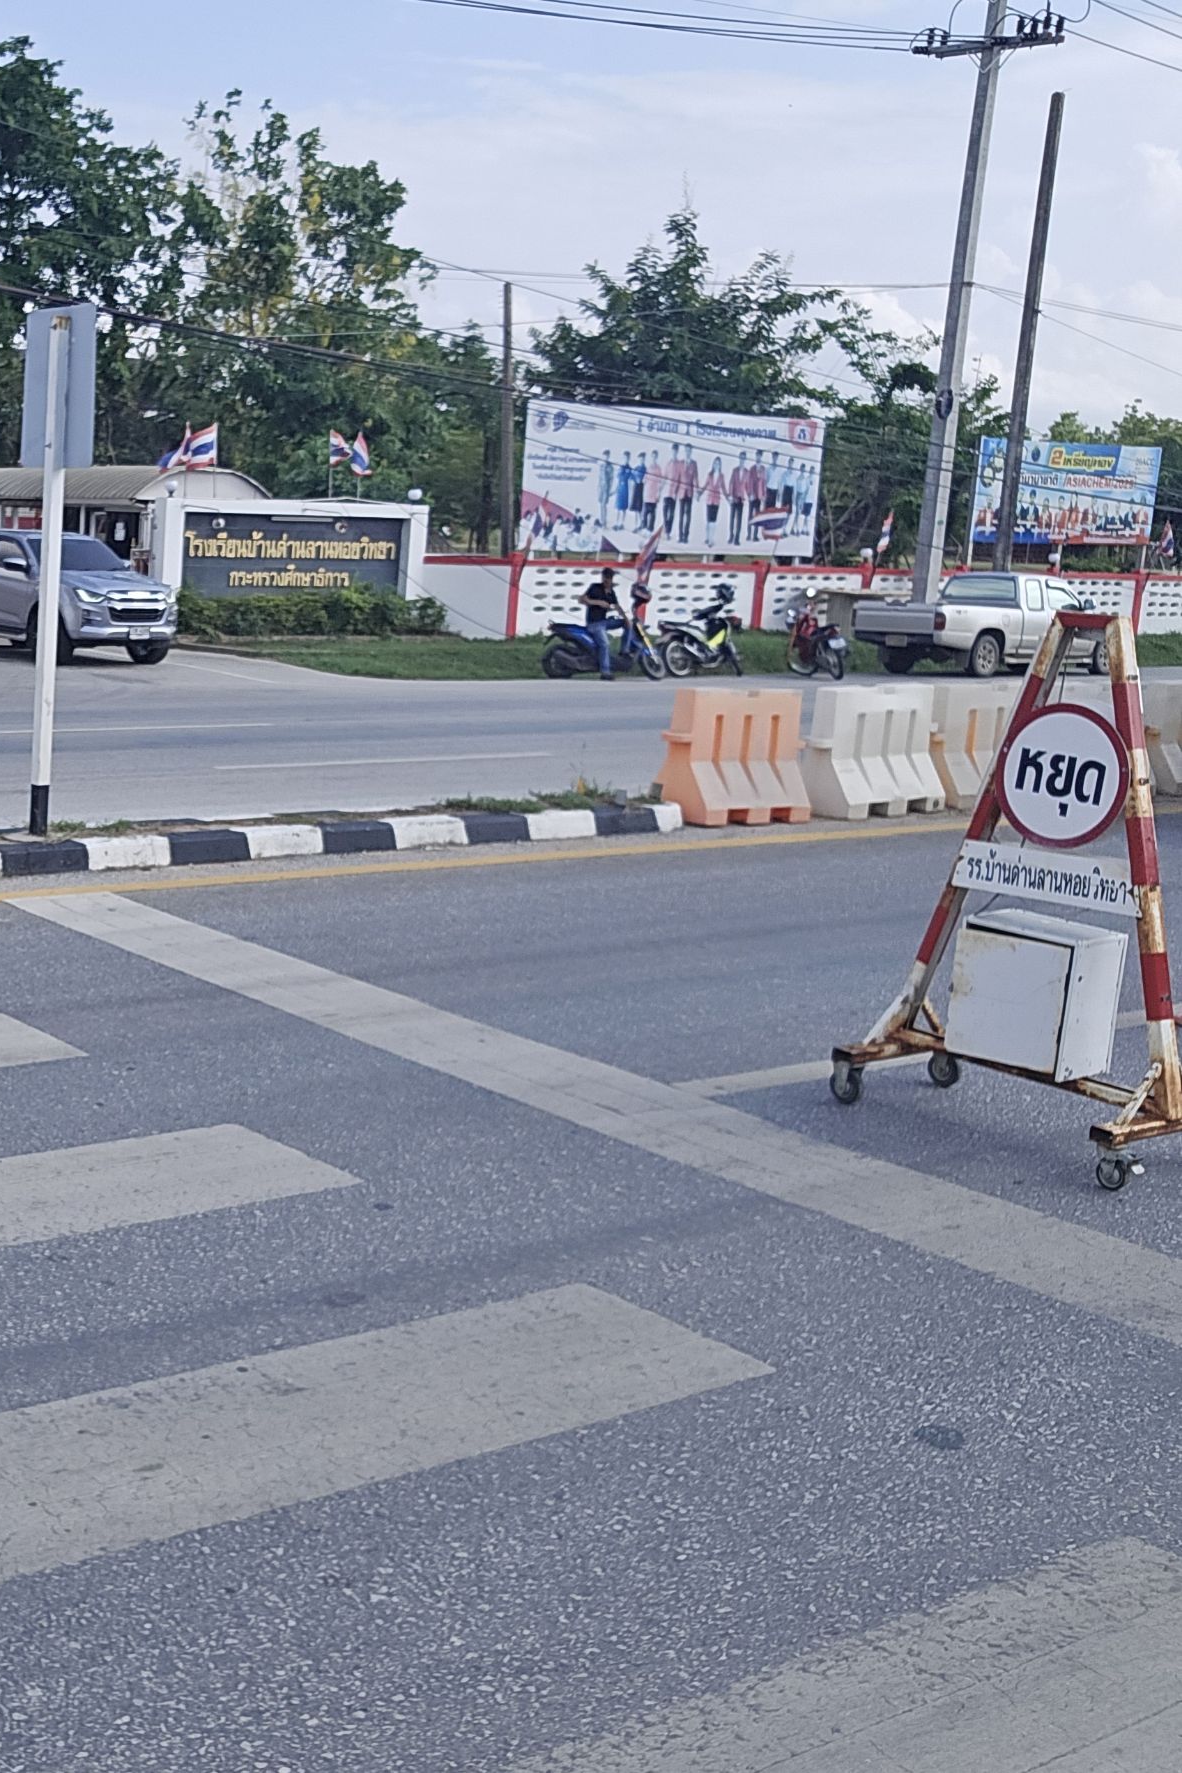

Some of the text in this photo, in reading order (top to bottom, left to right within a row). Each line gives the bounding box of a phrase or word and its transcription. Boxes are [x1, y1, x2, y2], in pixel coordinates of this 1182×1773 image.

[185, 530, 396, 560] โรงเรียนบ้านด่านลานหอยวิทยา
[229, 563, 350, 587] กระทรวงศึกษาธิการ
[1014, 746, 1108, 818] หยุด
